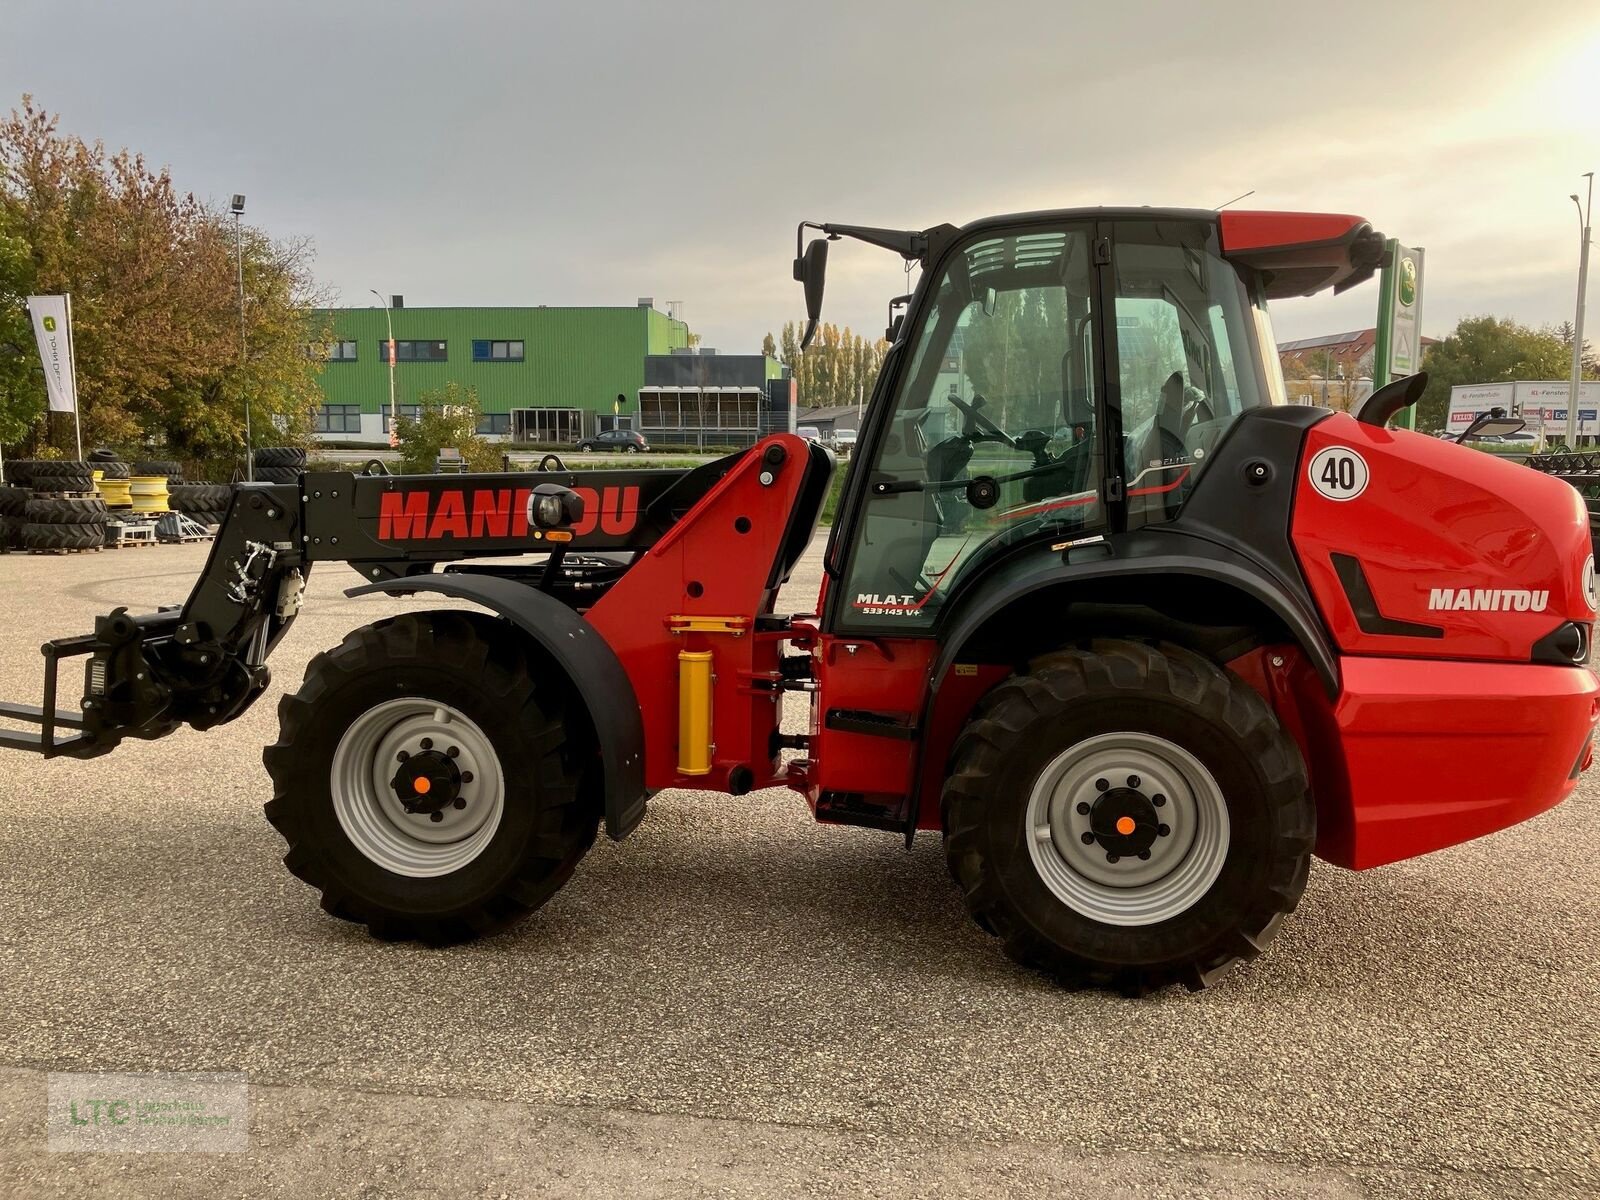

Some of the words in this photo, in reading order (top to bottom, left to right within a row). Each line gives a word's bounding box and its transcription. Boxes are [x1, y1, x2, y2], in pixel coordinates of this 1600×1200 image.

[1321, 457, 1355, 490] 40
[378, 486, 640, 540] MANIOU
[856, 593, 914, 606] MLA-T
[1428, 588, 1550, 612] MANITOU
